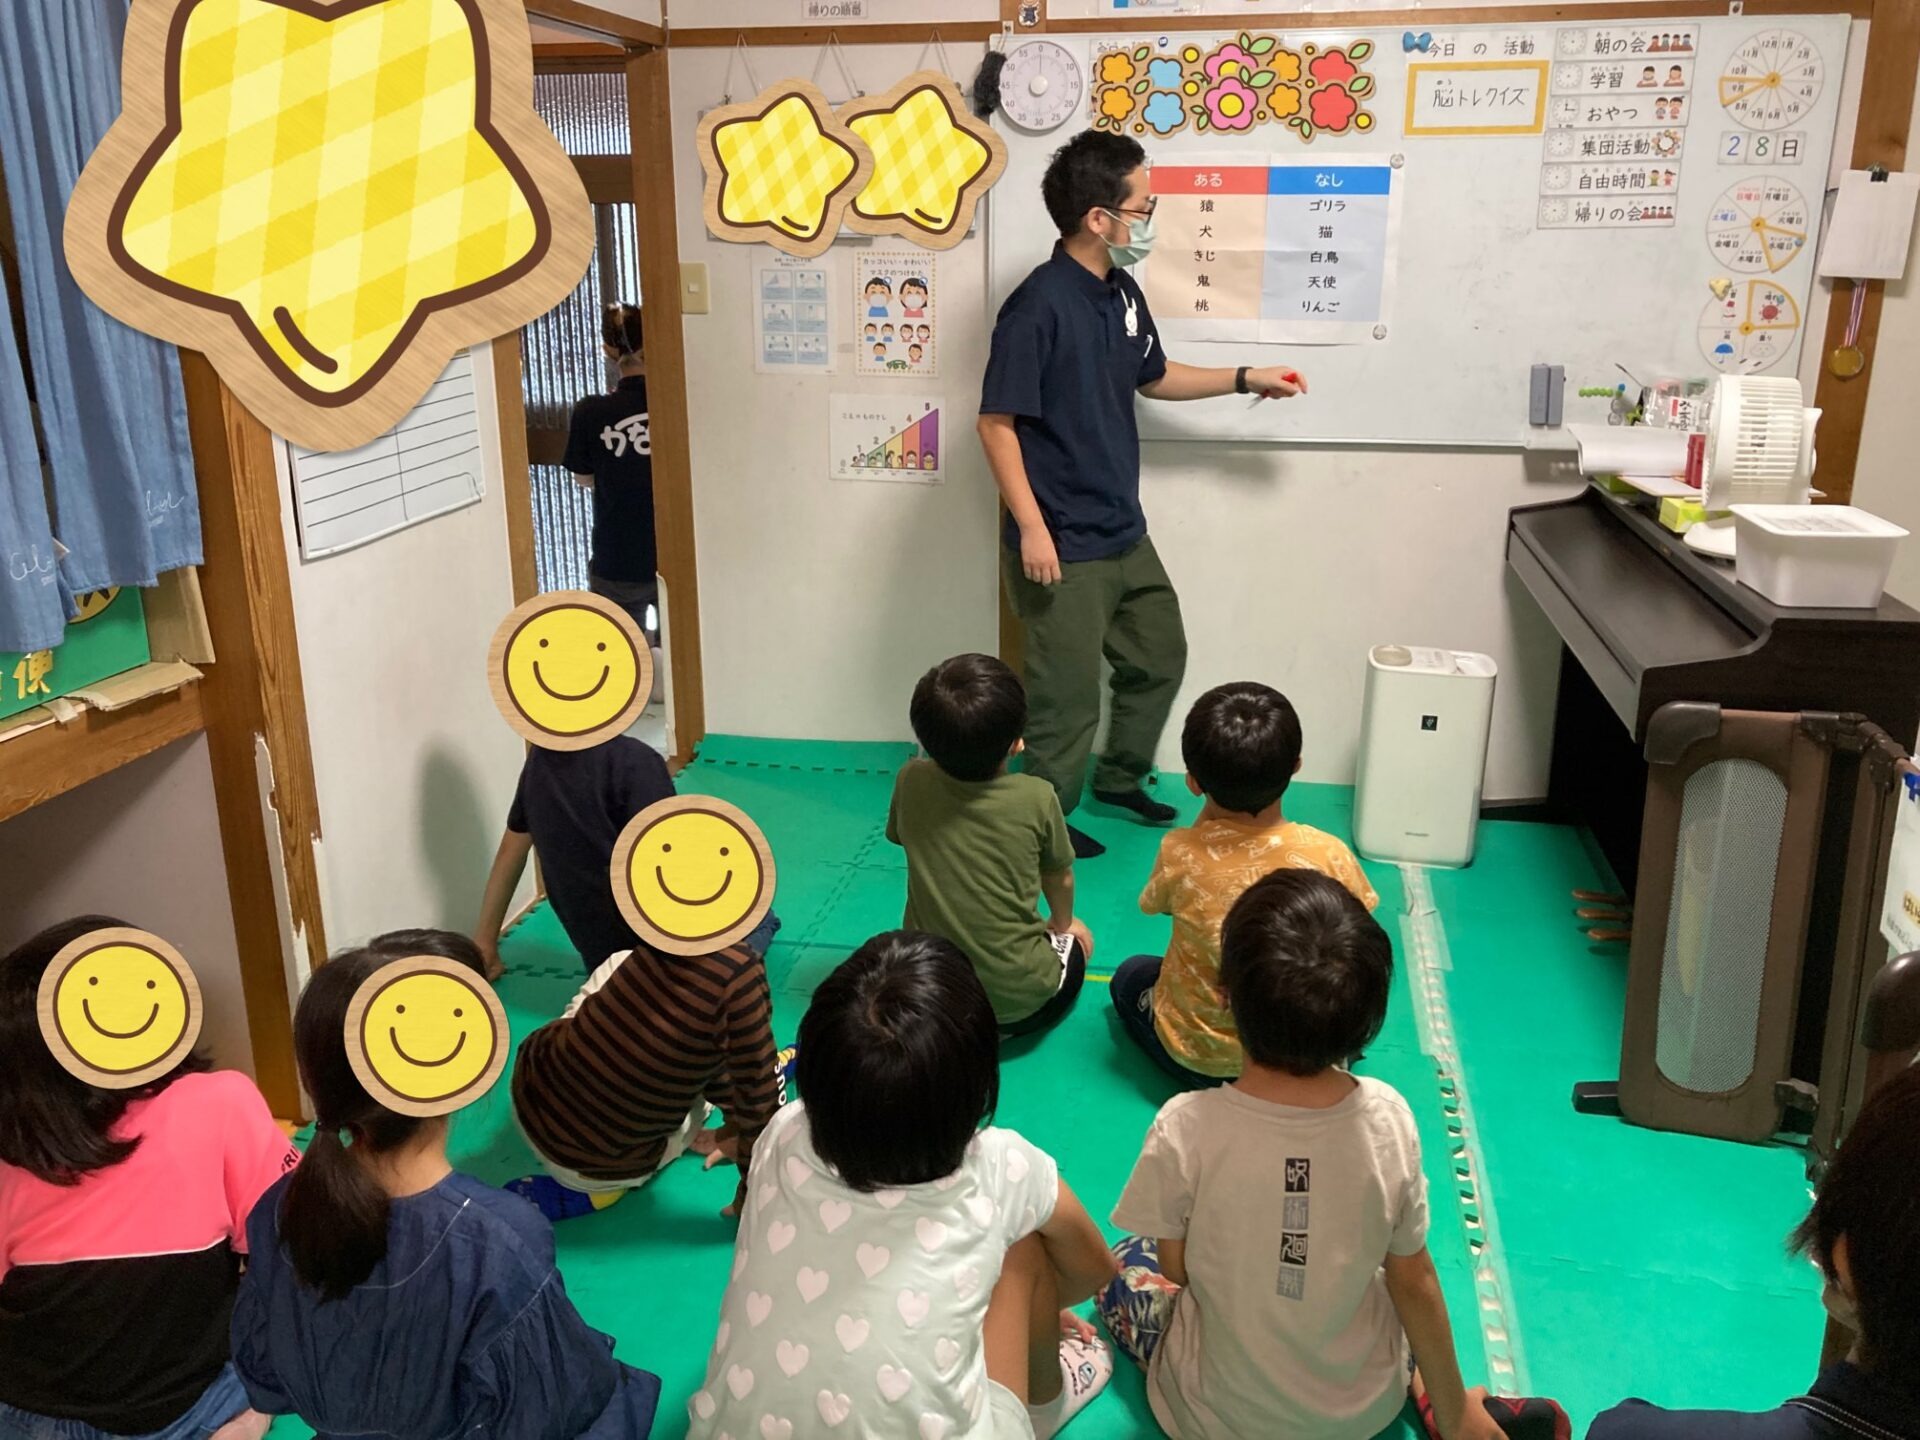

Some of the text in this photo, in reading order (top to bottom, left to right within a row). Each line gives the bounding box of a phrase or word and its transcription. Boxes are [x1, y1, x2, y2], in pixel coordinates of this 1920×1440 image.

[1429, 40, 1535, 58] 今日 の 活動
[1594, 37, 1647, 55] 朝の会
[1761, 40, 1778, 49] 12月
[1781, 40, 1793, 49] 1月
[1742, 49, 1759, 58] 11月
[1731, 66, 1748, 75] 10月
[1590, 72, 1623, 89] 学習
[1432, 87, 1530, 107] 脳トレクイズ
[1587, 106, 1638, 122] おやつ
[1751, 110, 1763, 119] 7月
[1787, 104, 1800, 113] 5月
[1768, 111, 1780, 120] 6月
[1581, 139, 1650, 156] 集団活動
[1194, 173, 1223, 187] ある
[1315, 173, 1343, 187] なし
[1579, 173, 1646, 189] 自由時間
[1764, 192, 1789, 201] 月曜日
[1200, 200, 1214, 212] 猿
[1309, 200, 1346, 212] ゴリラ
[1575, 206, 1642, 223] 帰りの会
[1199, 225, 1213, 238] 犬
[1318, 225, 1333, 239] 猫
[1194, 250, 1216, 262] きじ
[1310, 251, 1339, 264] 白鳥
[1197, 275, 1210, 287] 鬼
[1308, 276, 1337, 289] 天使
[1195, 299, 1209, 312] 桃
[1302, 301, 1340, 313] りんご
